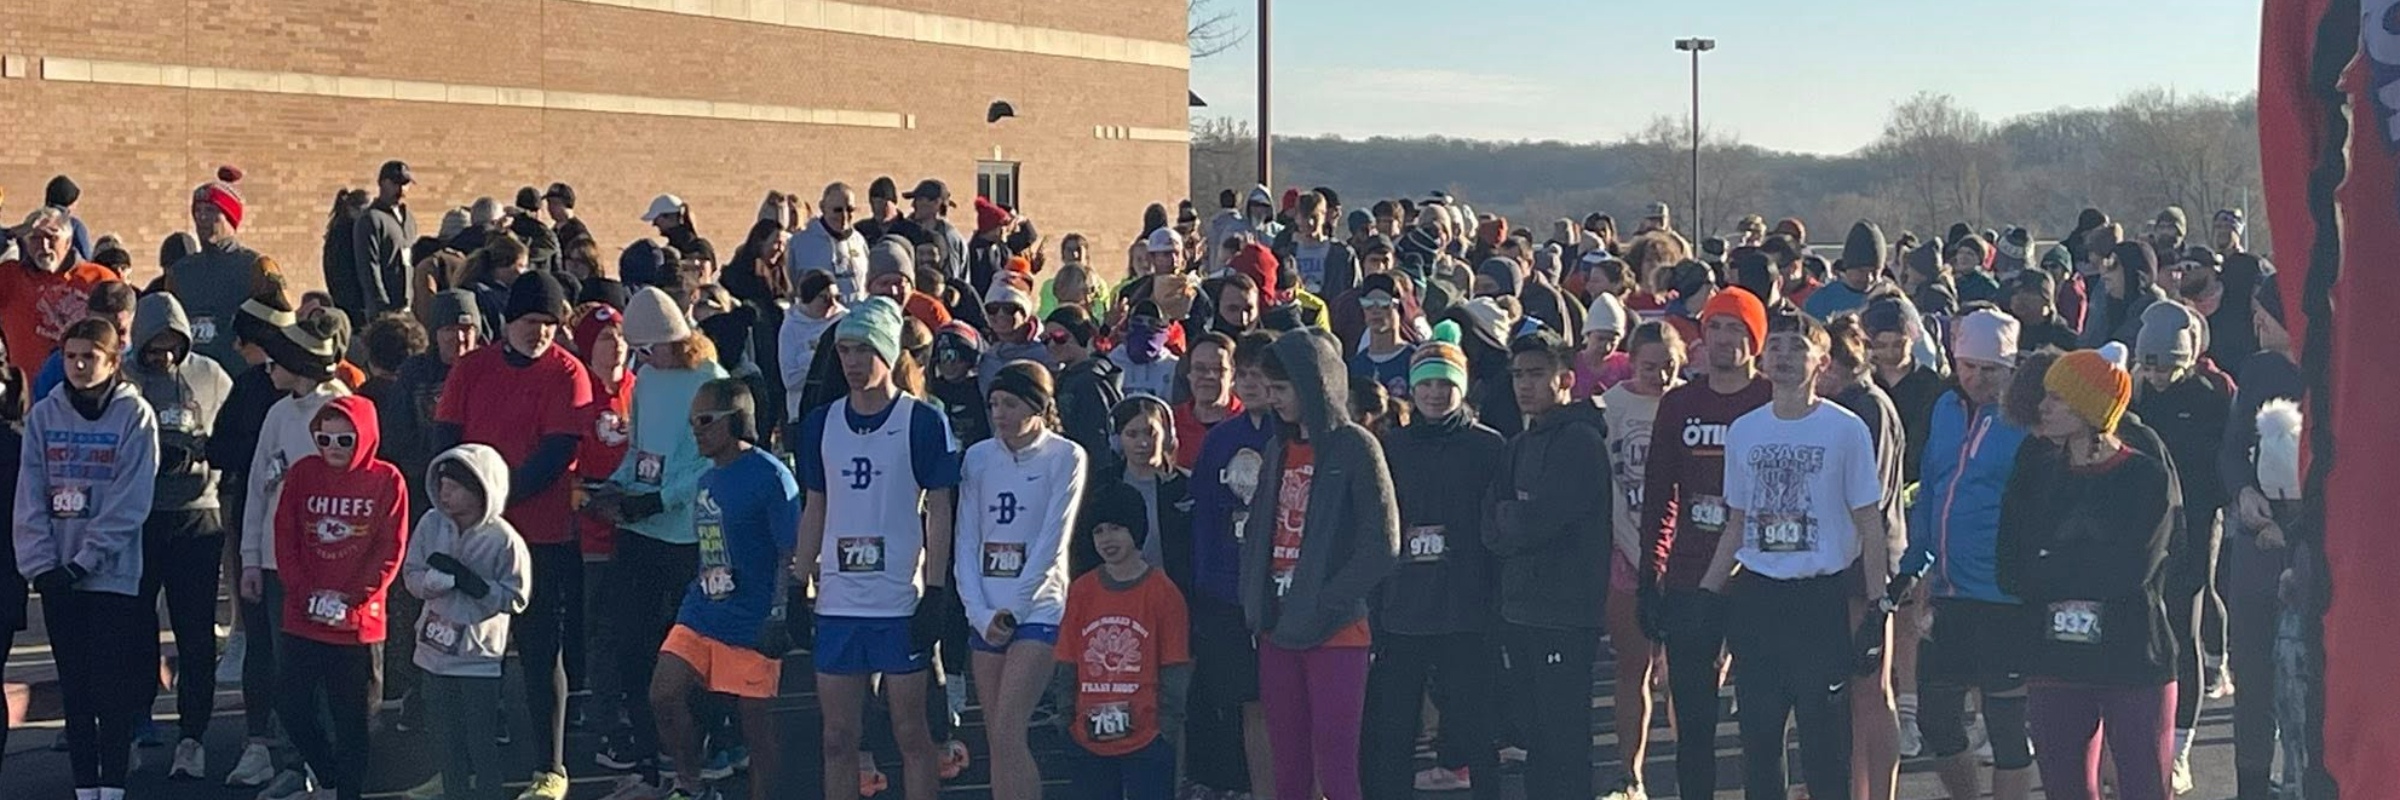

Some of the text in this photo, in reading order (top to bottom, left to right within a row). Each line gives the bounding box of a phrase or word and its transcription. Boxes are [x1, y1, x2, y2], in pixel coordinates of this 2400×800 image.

[1748, 444, 1825, 468] OSAGE
[851, 457, 872, 490] B
[307, 496, 375, 517] CHIEFS
[996, 491, 1017, 525] B
[1764, 522, 1800, 544] 943
[989, 552, 1020, 571] 780
[2054, 611, 2094, 634] 937
[425, 622, 456, 647] 920
